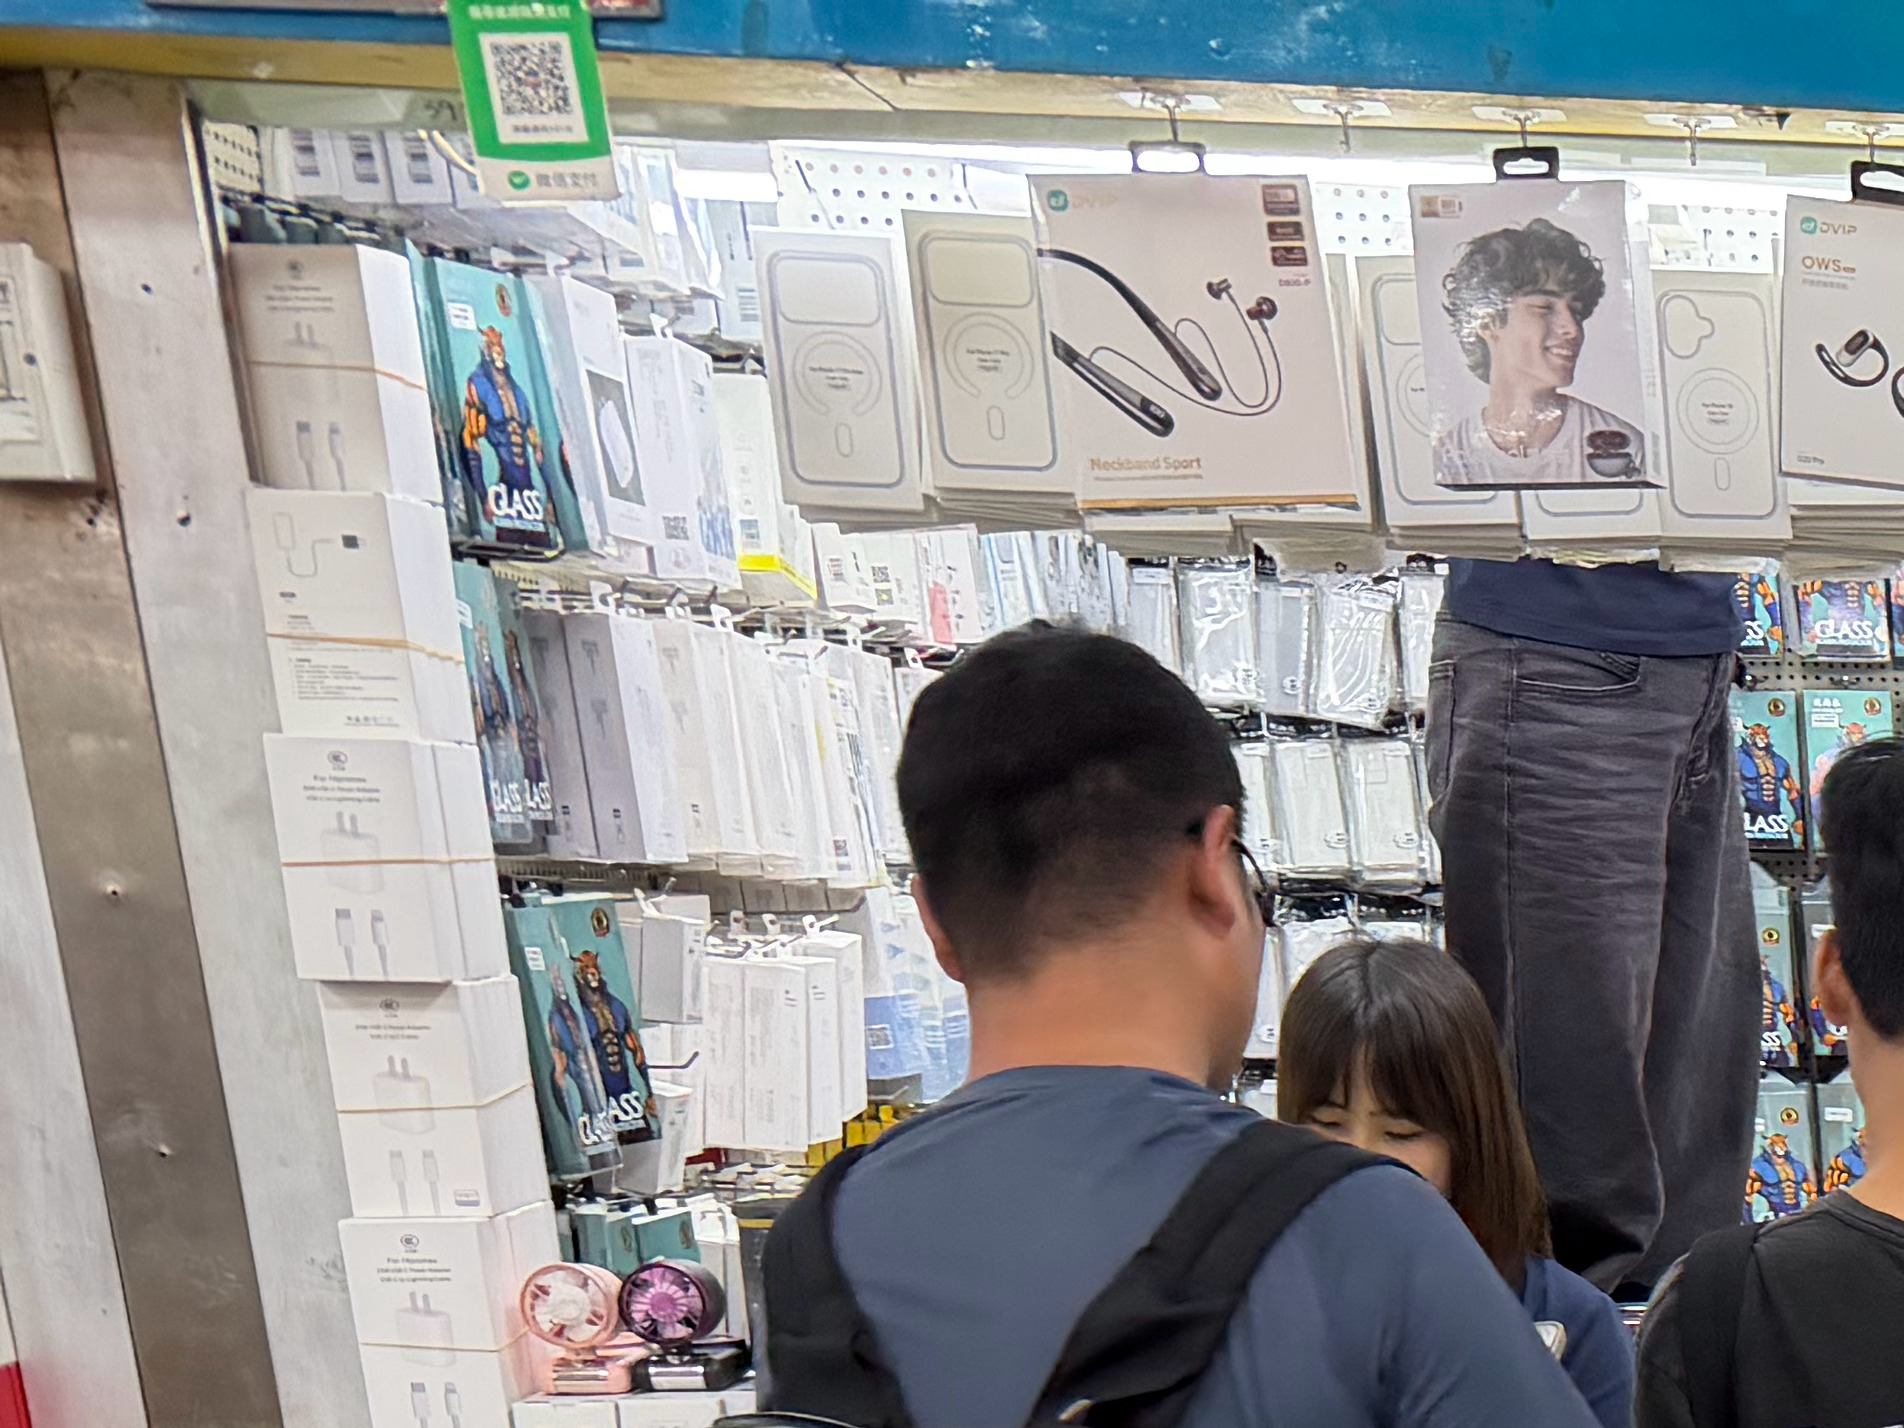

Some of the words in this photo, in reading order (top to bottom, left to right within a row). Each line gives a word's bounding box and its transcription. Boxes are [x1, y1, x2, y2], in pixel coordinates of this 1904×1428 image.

[1820, 222, 1857, 235] DVIP
[1802, 256, 1841, 272] OWS
[1089, 456, 1160, 472] Neckband
[1163, 456, 1202, 472] Sport
[487, 483, 544, 521] GLASS
[1814, 620, 1874, 639] GLASS
[1743, 812, 1789, 833] LASS
